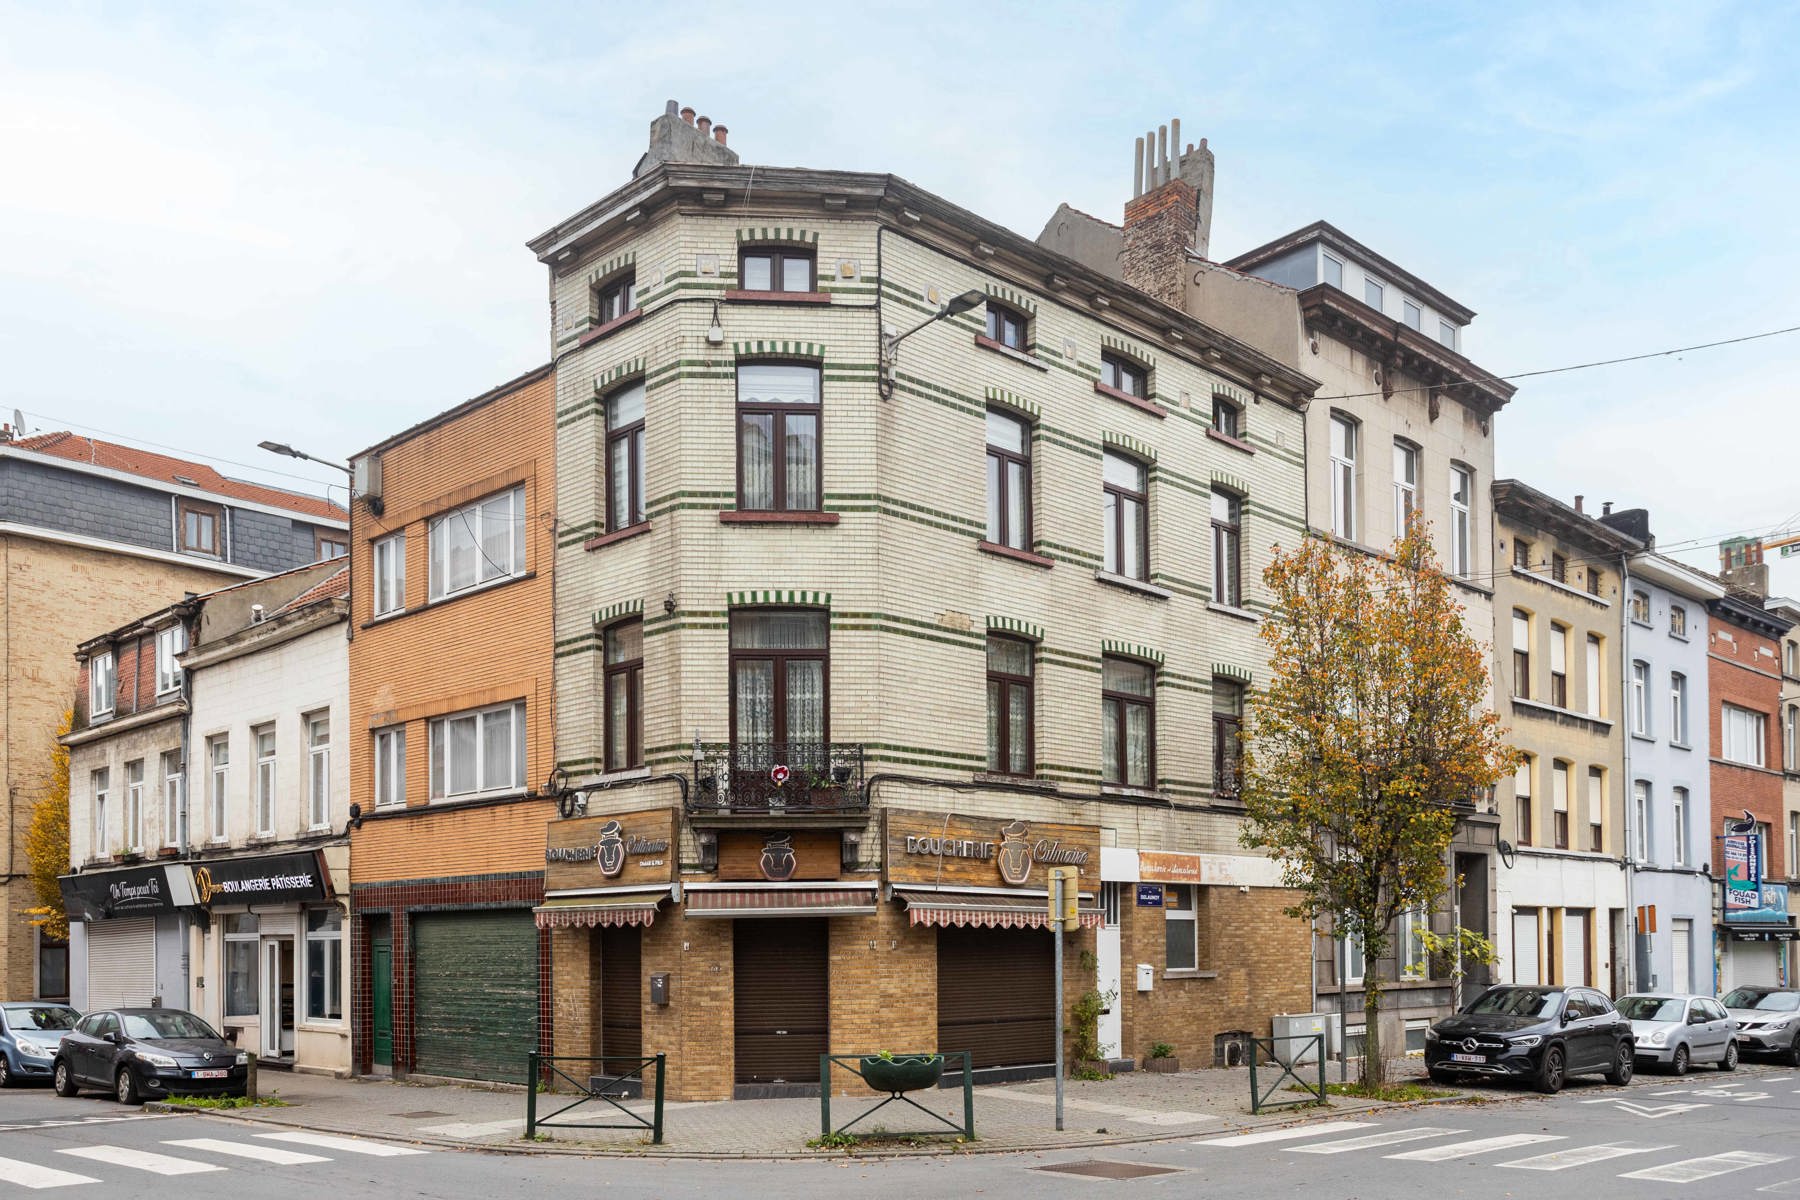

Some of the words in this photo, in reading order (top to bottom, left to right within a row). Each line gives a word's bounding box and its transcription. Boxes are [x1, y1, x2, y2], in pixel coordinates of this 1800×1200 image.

[546, 844, 597, 862] BOUCHERIE
[906, 836, 995, 859] BOUCHERIE
[1034, 840, 1088, 865] Culinaire
[120, 881, 136, 899] Temps
[1729, 889, 1757, 900] FOUAD
[1734, 896, 1751, 905] FISH
